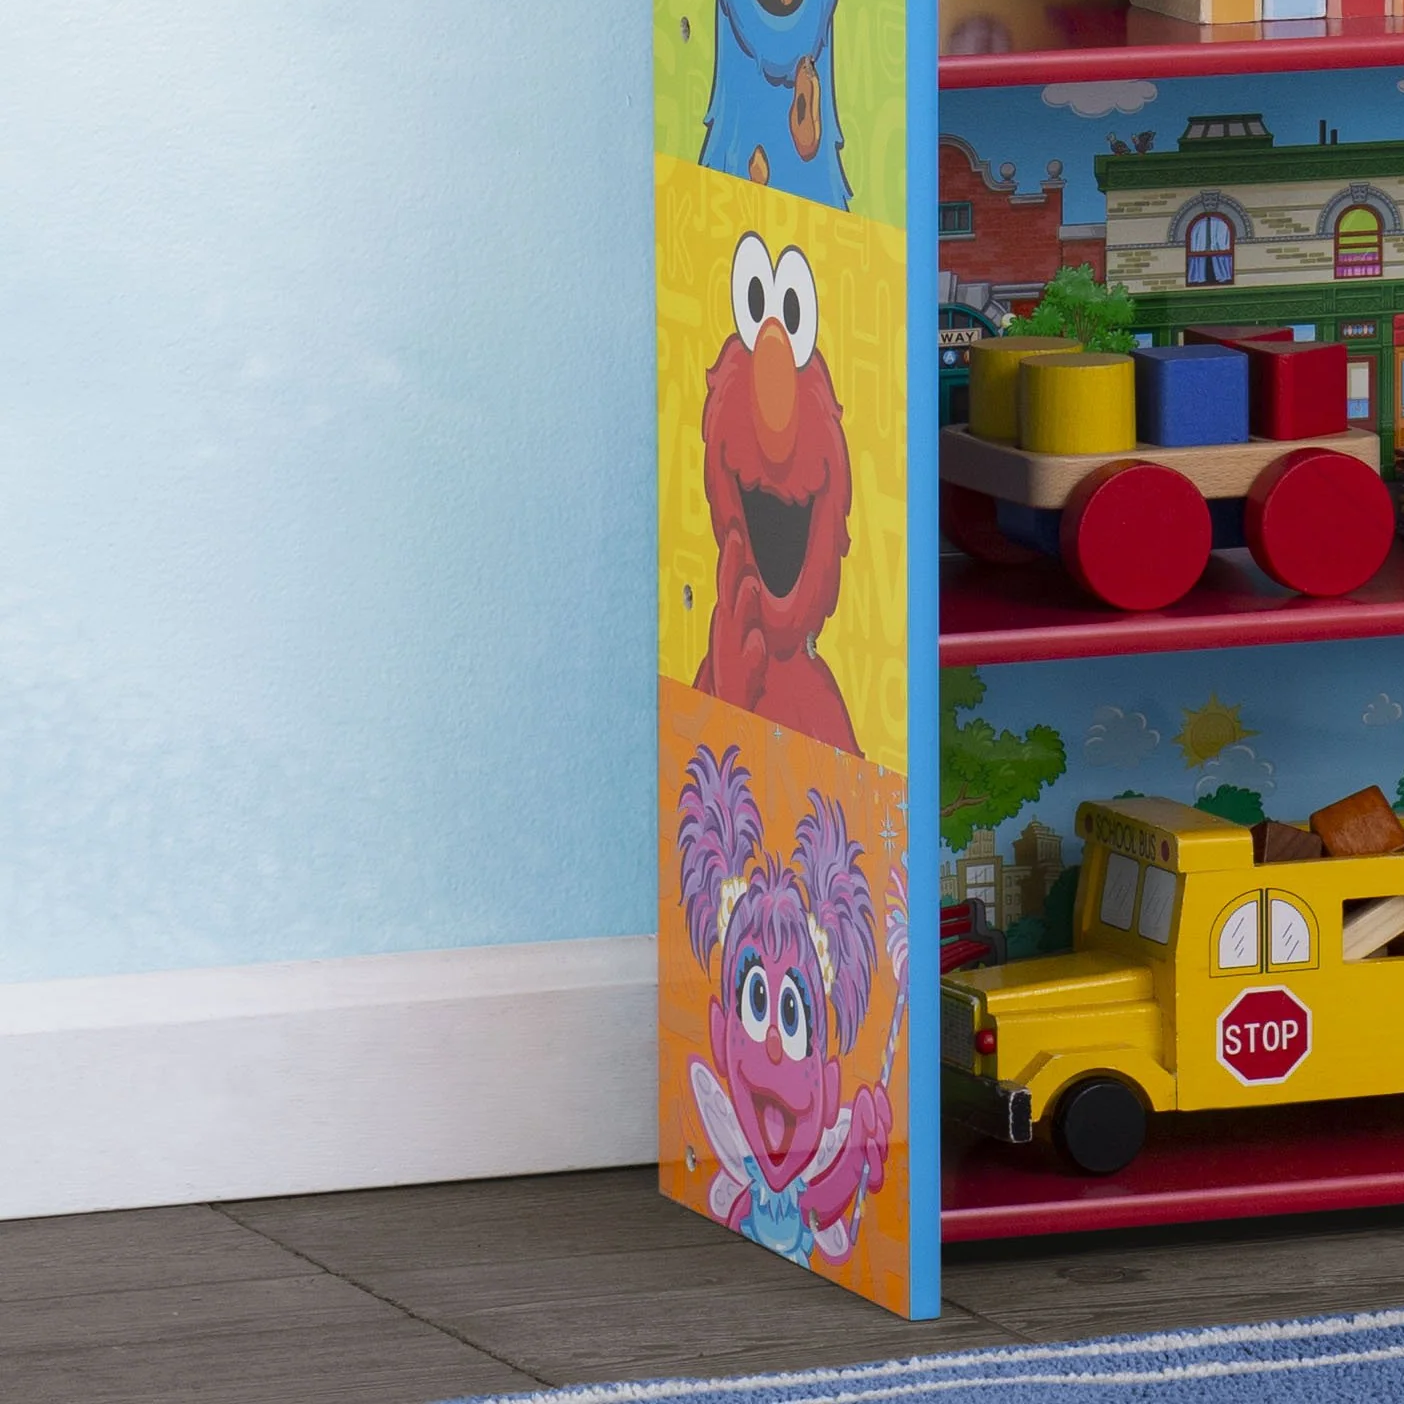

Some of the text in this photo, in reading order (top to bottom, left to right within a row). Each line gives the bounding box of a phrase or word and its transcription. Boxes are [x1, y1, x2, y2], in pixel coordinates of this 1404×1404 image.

[1095, 814, 1157, 862] SCHOOL BUS
[1224, 1018, 1299, 1056] STOP
